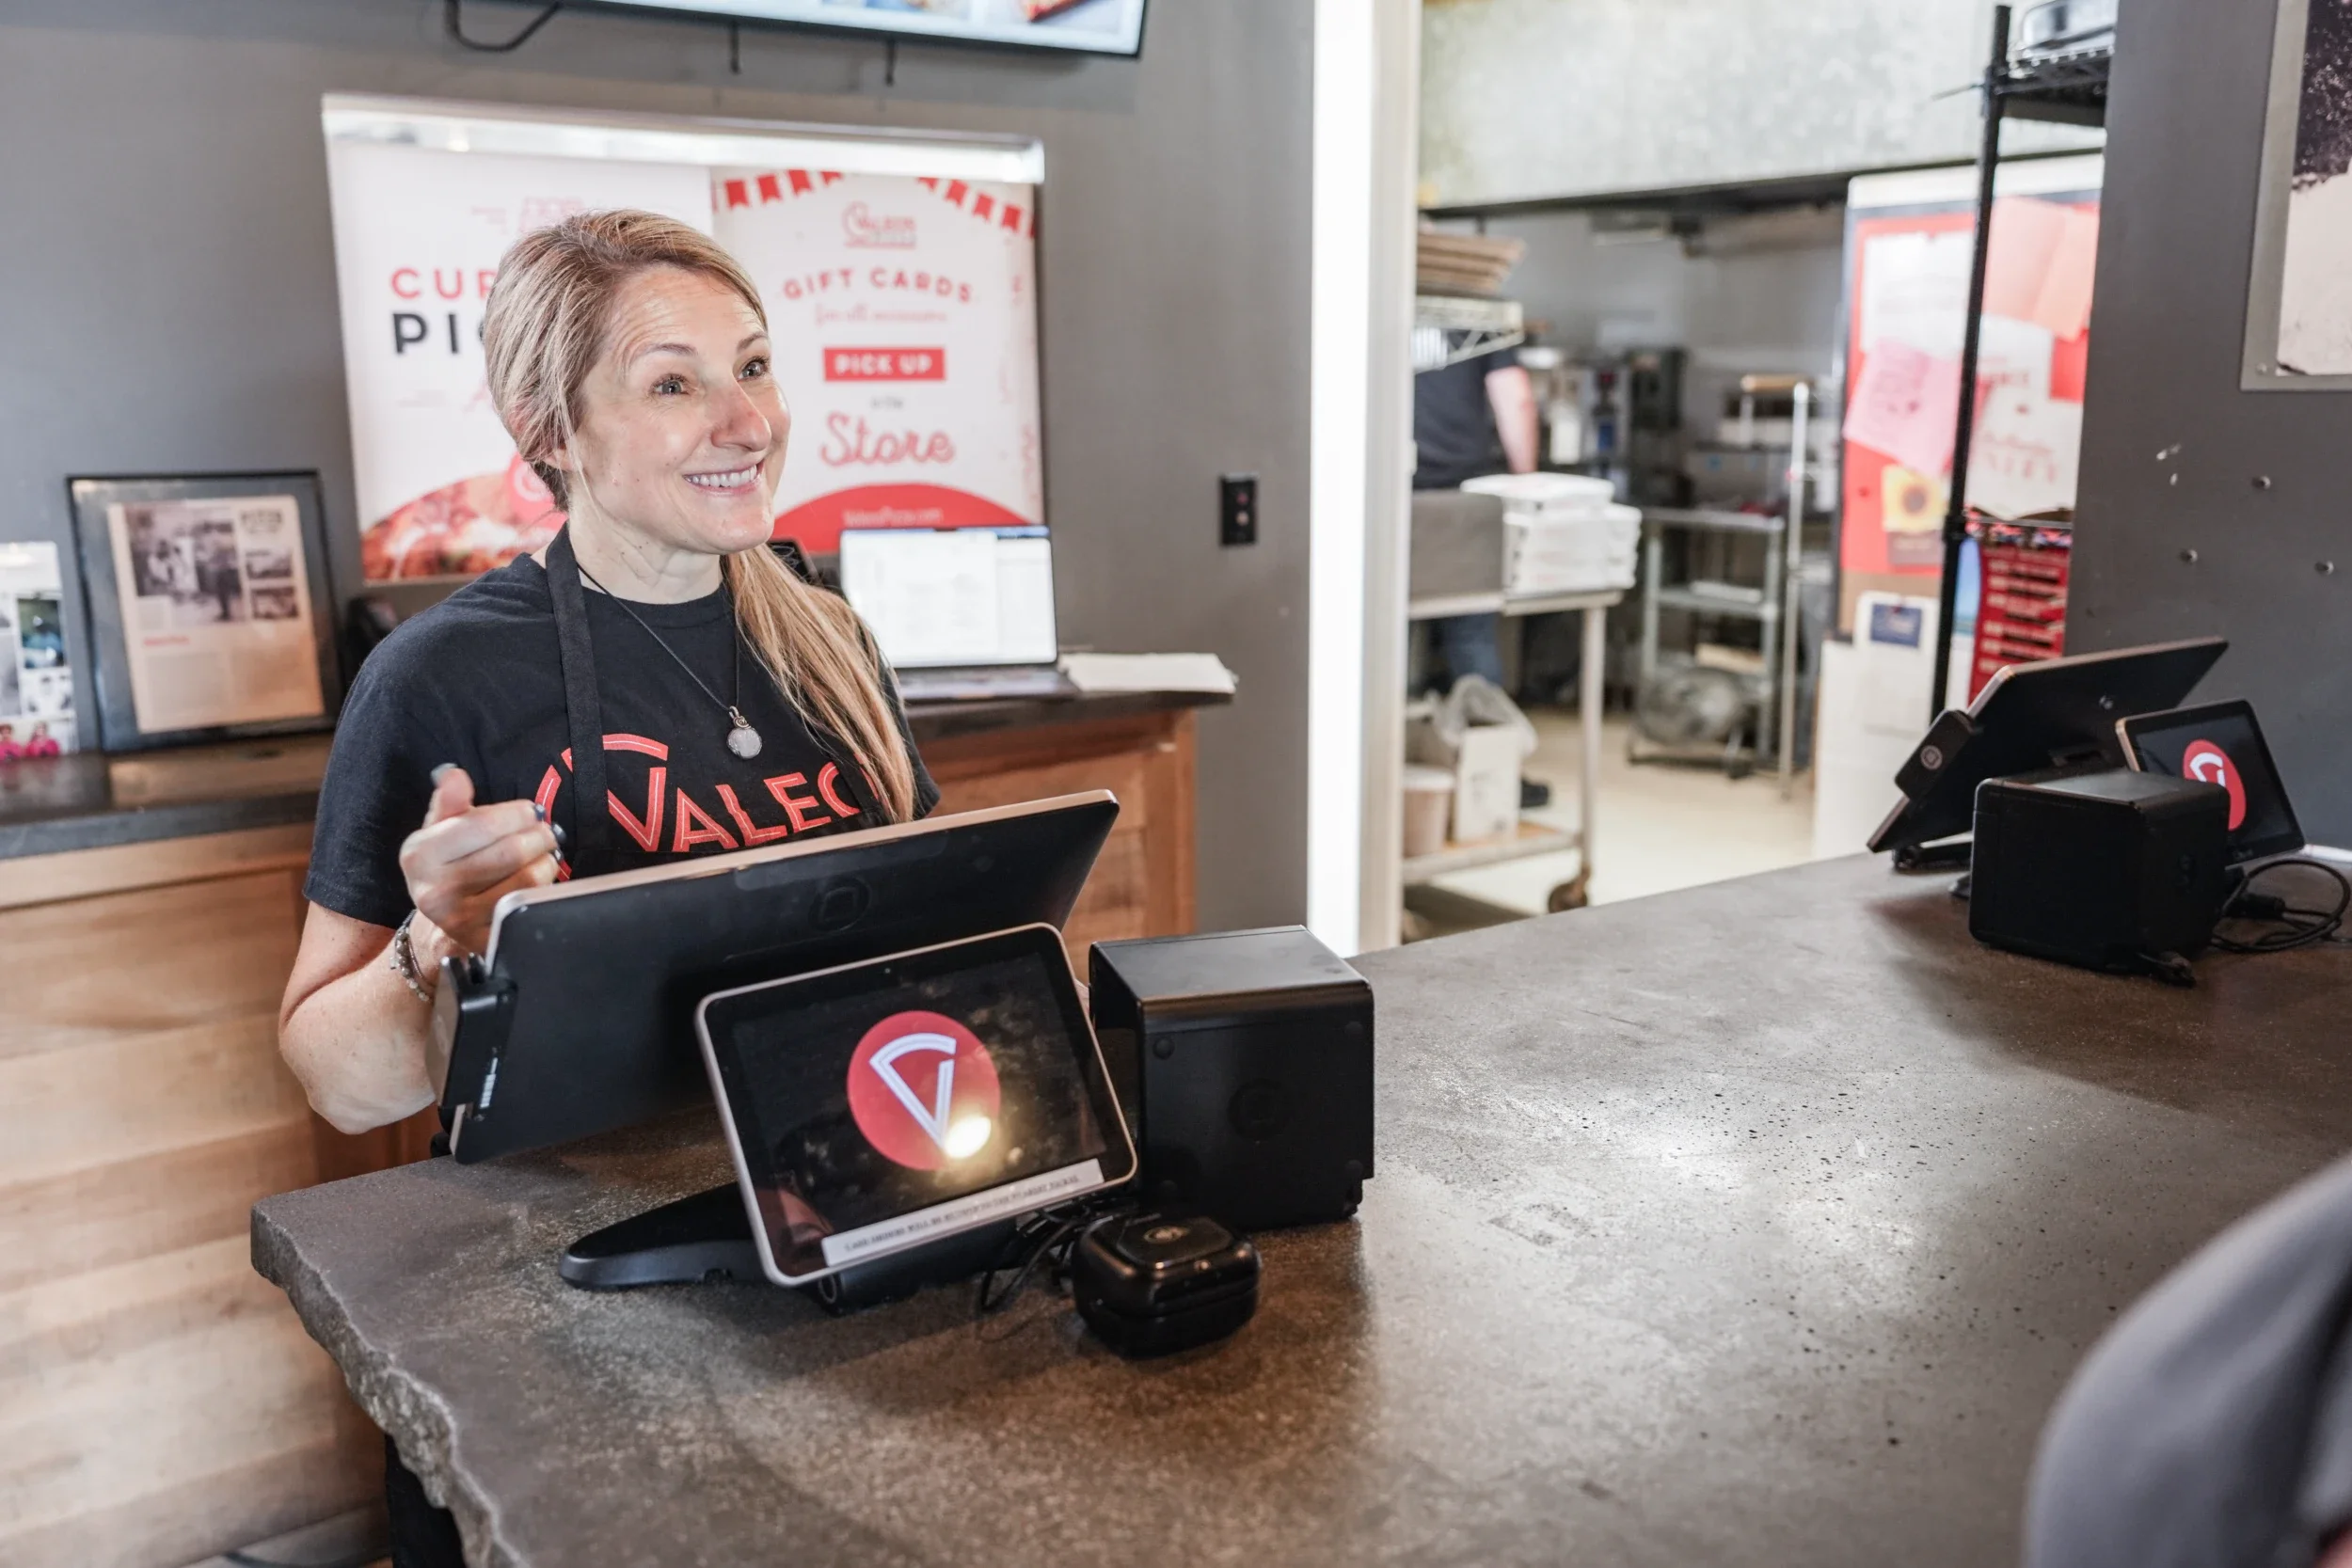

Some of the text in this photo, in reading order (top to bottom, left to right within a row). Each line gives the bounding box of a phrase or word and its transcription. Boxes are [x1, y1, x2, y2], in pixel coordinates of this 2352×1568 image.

[784, 266, 971, 304] GIFT CARDS
[391, 311, 486, 355] PI
[834, 354, 933, 376] PICK UP
[819, 411, 956, 467] Store
